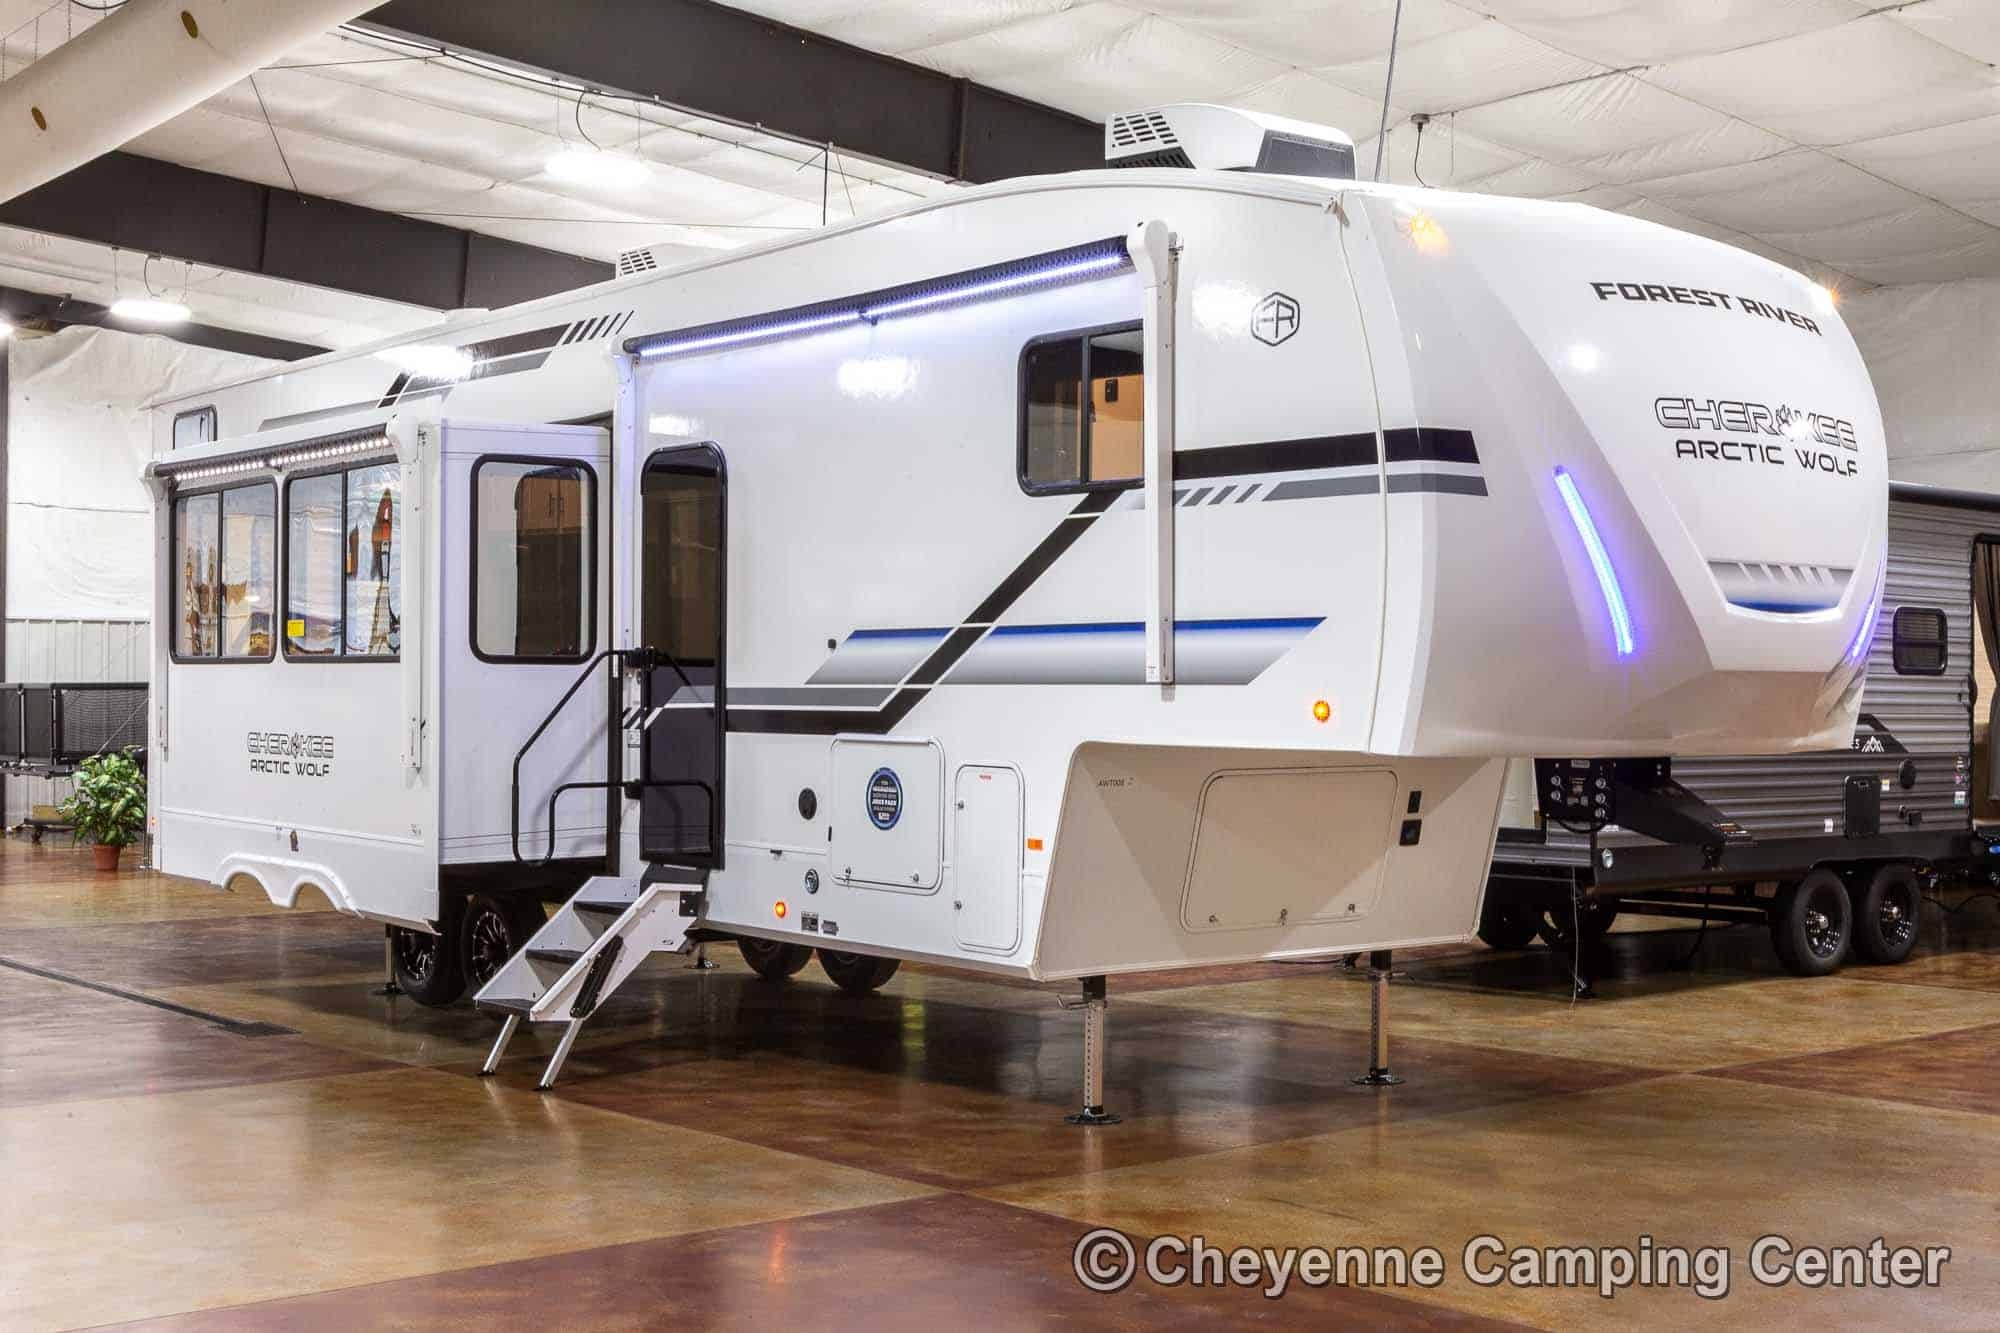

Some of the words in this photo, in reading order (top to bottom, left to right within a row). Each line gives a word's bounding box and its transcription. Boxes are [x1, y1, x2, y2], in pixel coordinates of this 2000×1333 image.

[1590, 282, 1731, 310] FOREST
[1736, 296, 1822, 336] RIVER
[1675, 439, 1785, 465] ARCTIC
[1795, 448, 1858, 477] WOLF
[250, 759, 290, 774] ARCTIC
[296, 762, 330, 777] WOLF
